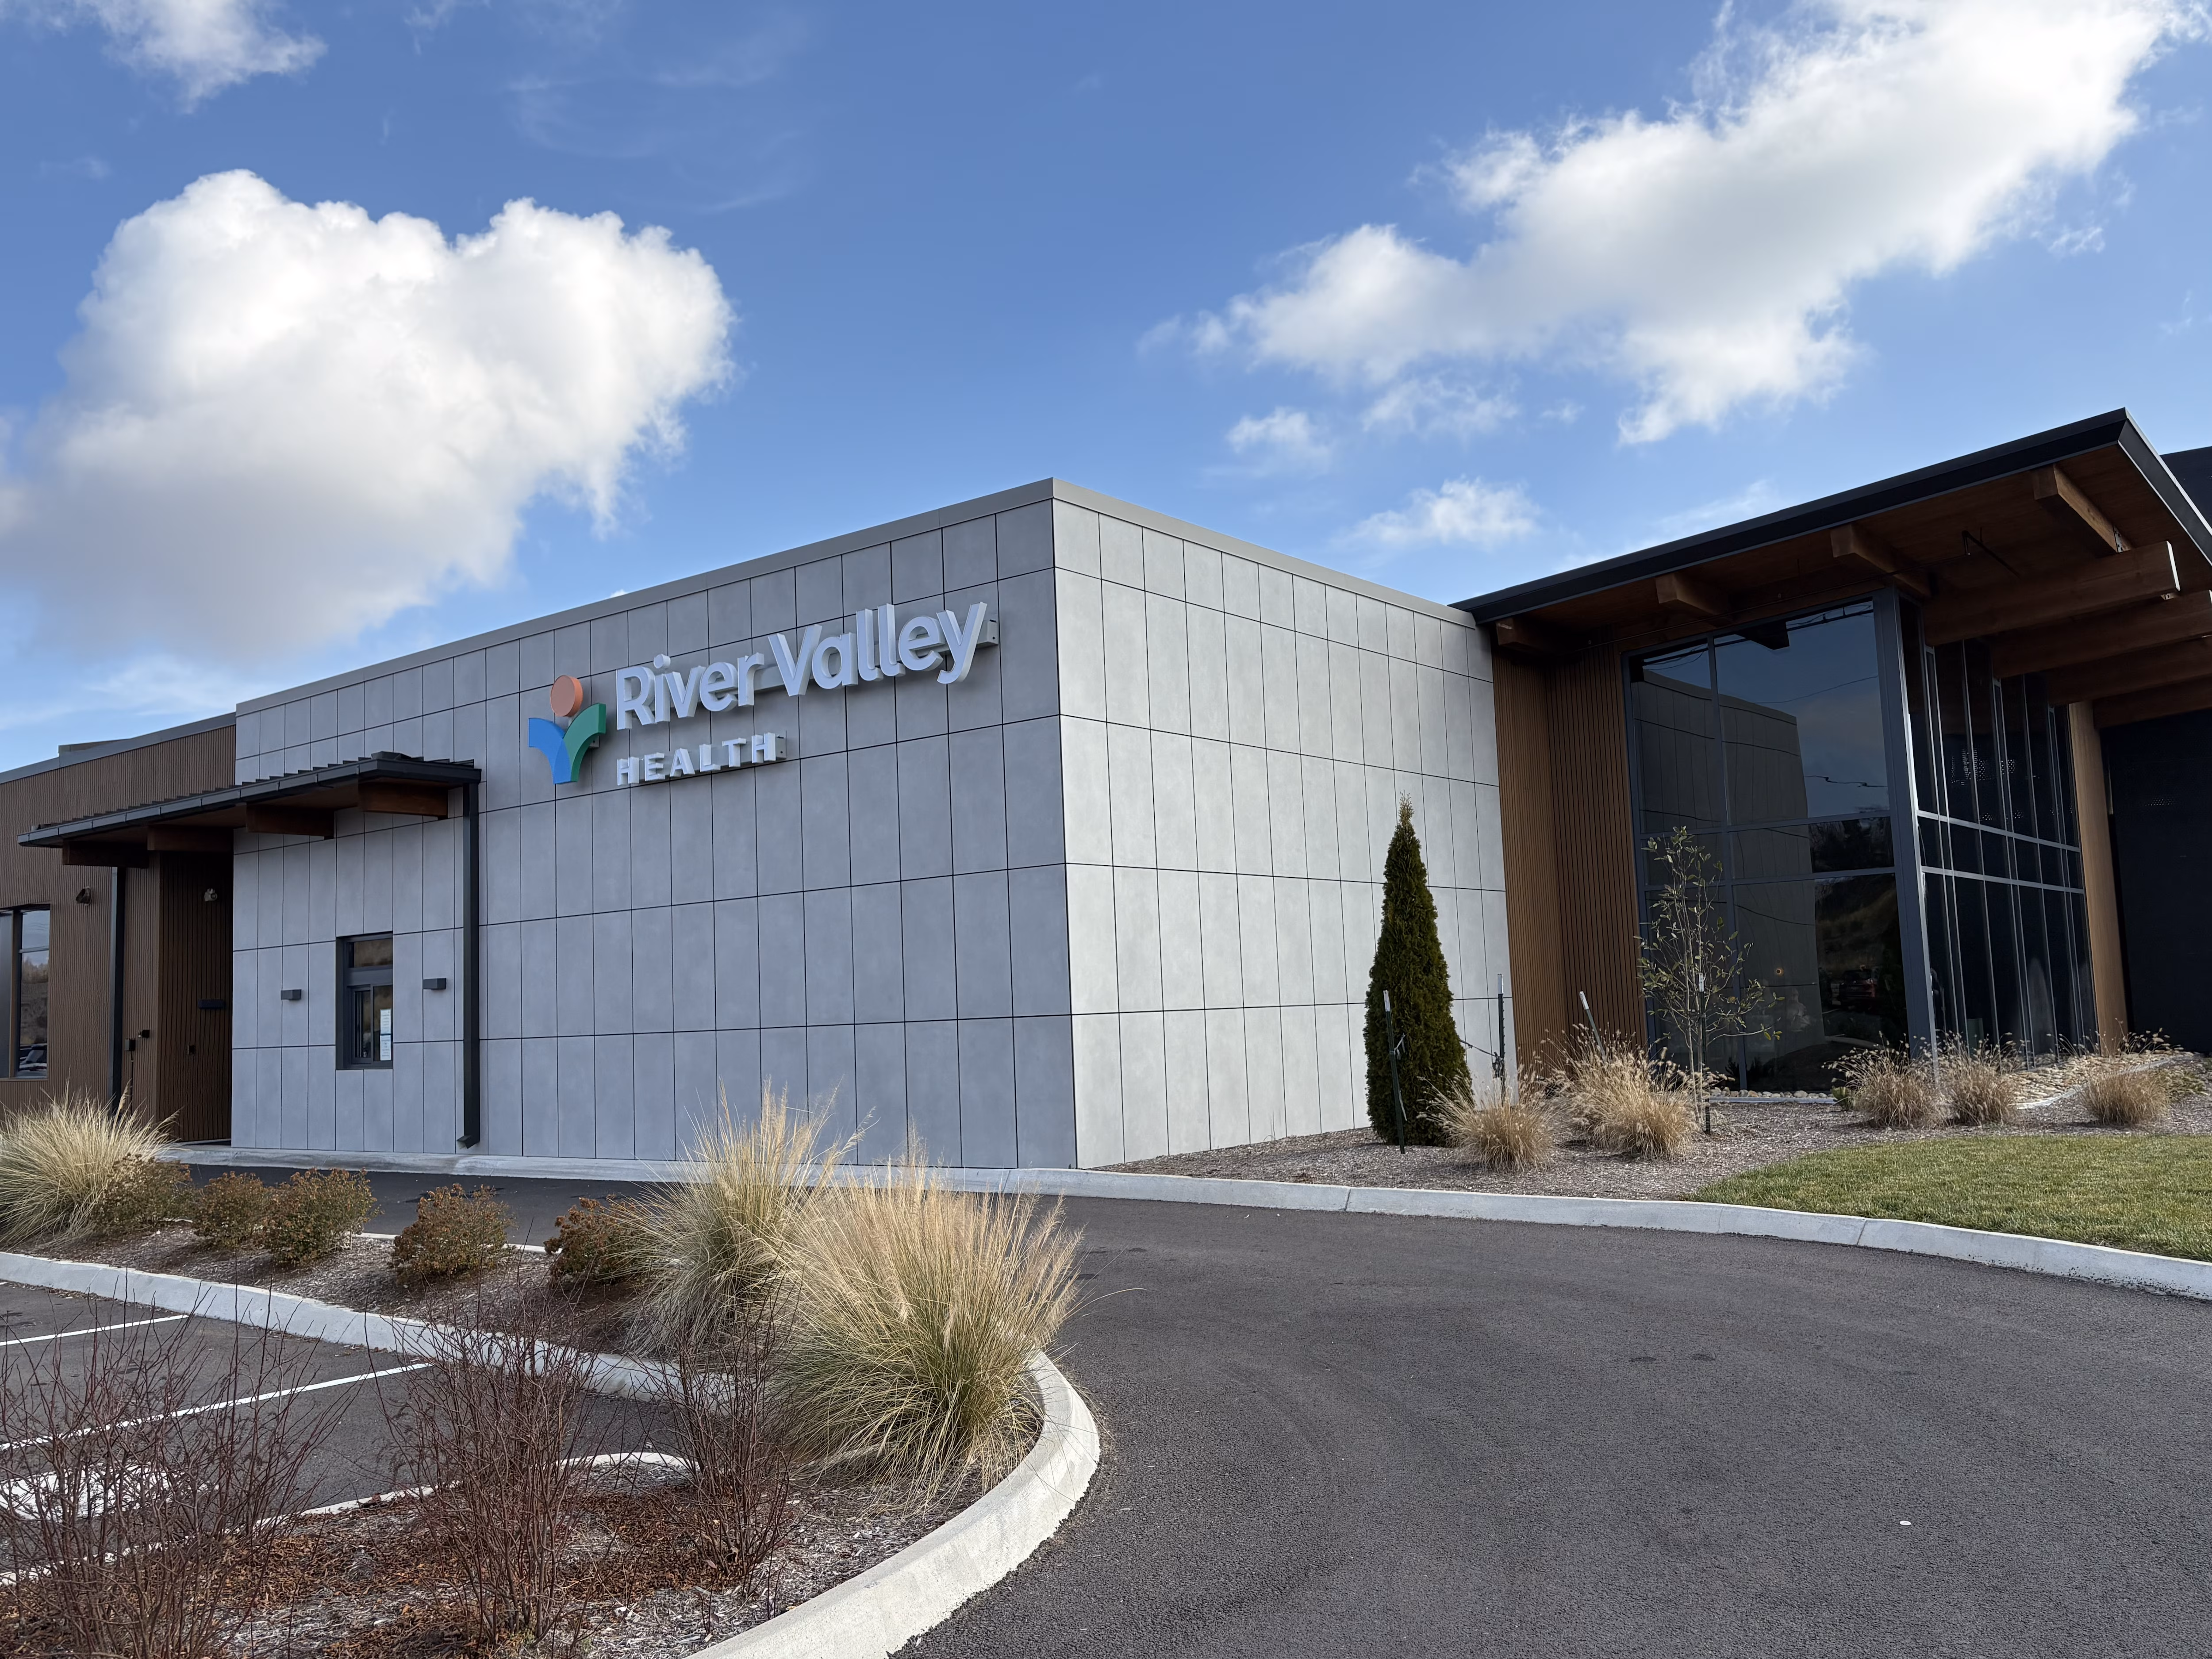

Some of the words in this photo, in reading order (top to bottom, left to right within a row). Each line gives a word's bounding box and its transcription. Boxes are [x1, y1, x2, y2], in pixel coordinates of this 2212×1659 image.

[616, 653, 764, 730] River
[768, 602, 987, 696] Valley
[617, 732, 776, 786] HEALTH
